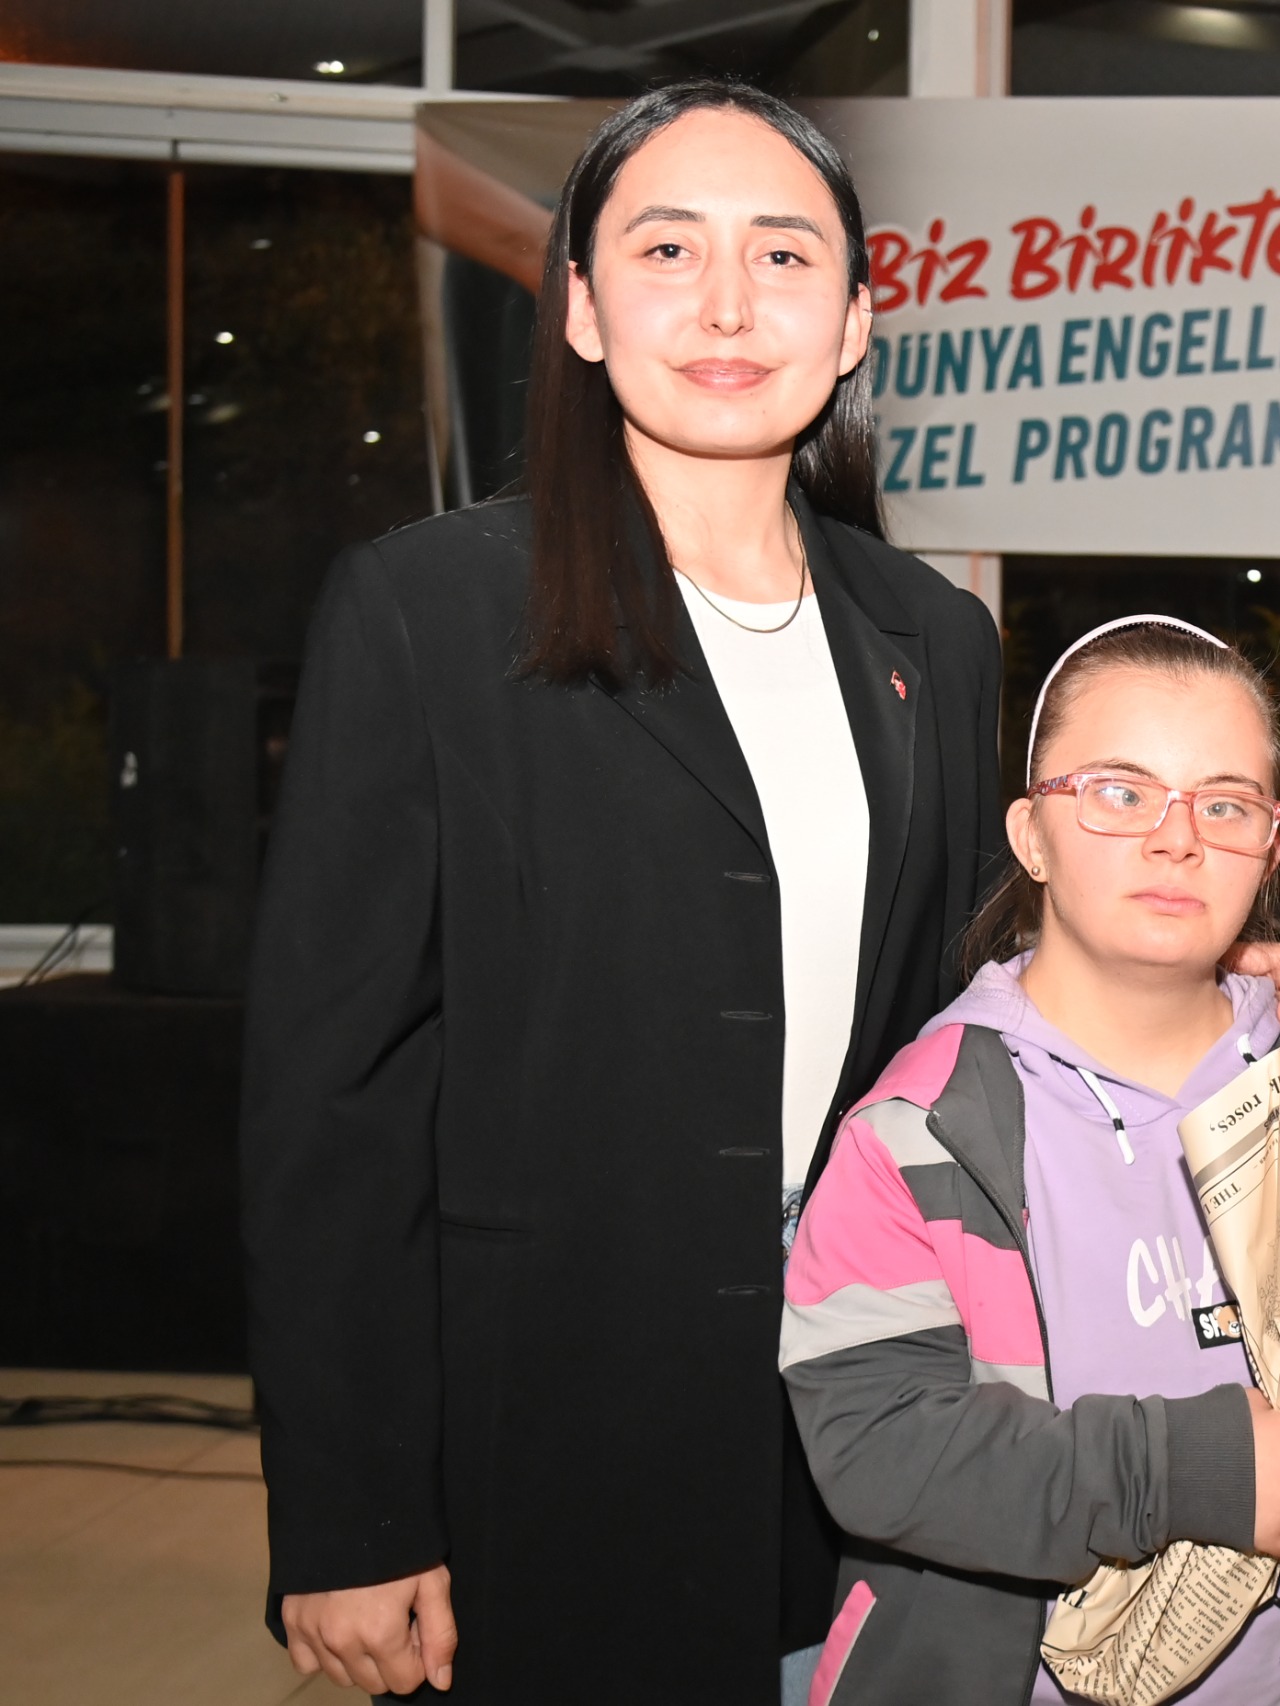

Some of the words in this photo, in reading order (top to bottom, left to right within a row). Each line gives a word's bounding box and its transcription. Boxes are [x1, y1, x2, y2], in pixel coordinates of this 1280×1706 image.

[876, 418, 985, 493] ZEL
[1209, 1094, 1264, 1134] roses,
[1209, 1182, 1242, 1210] THE
[1196, 1581, 1223, 1605] perennial
[1202, 1572, 1231, 1598] chamomile
[1165, 1610, 1191, 1641] hroughout
[1198, 1608, 1224, 1632] spreading
